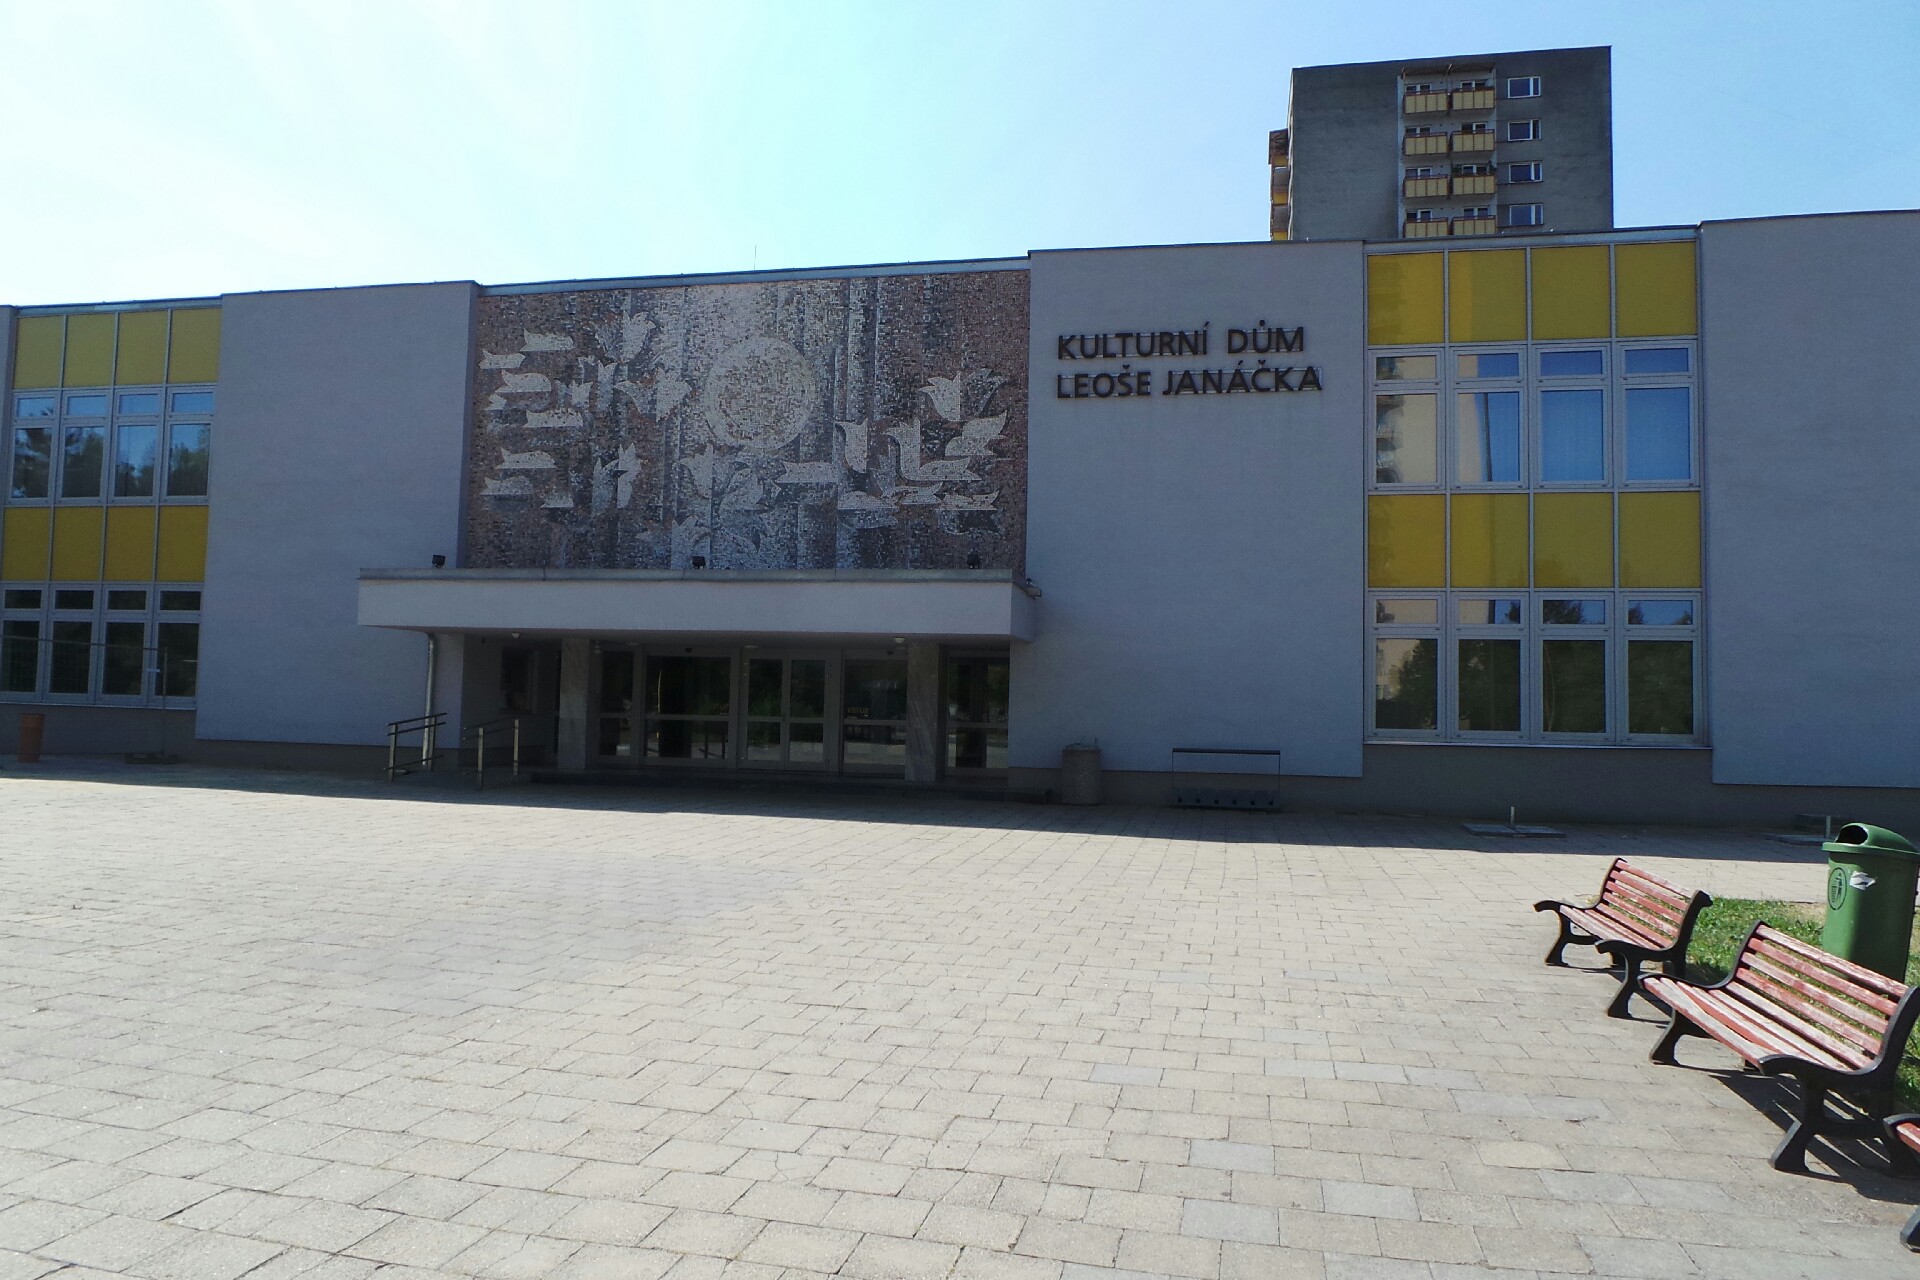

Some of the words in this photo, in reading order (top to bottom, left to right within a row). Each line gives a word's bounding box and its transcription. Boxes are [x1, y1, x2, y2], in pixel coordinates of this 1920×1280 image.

[1057, 321, 1209, 360] KULTURNÍ
[1227, 319, 1304, 354] DŮM
[1057, 364, 1151, 398] LEOŠE
[1162, 359, 1323, 396] JANÁČKA
